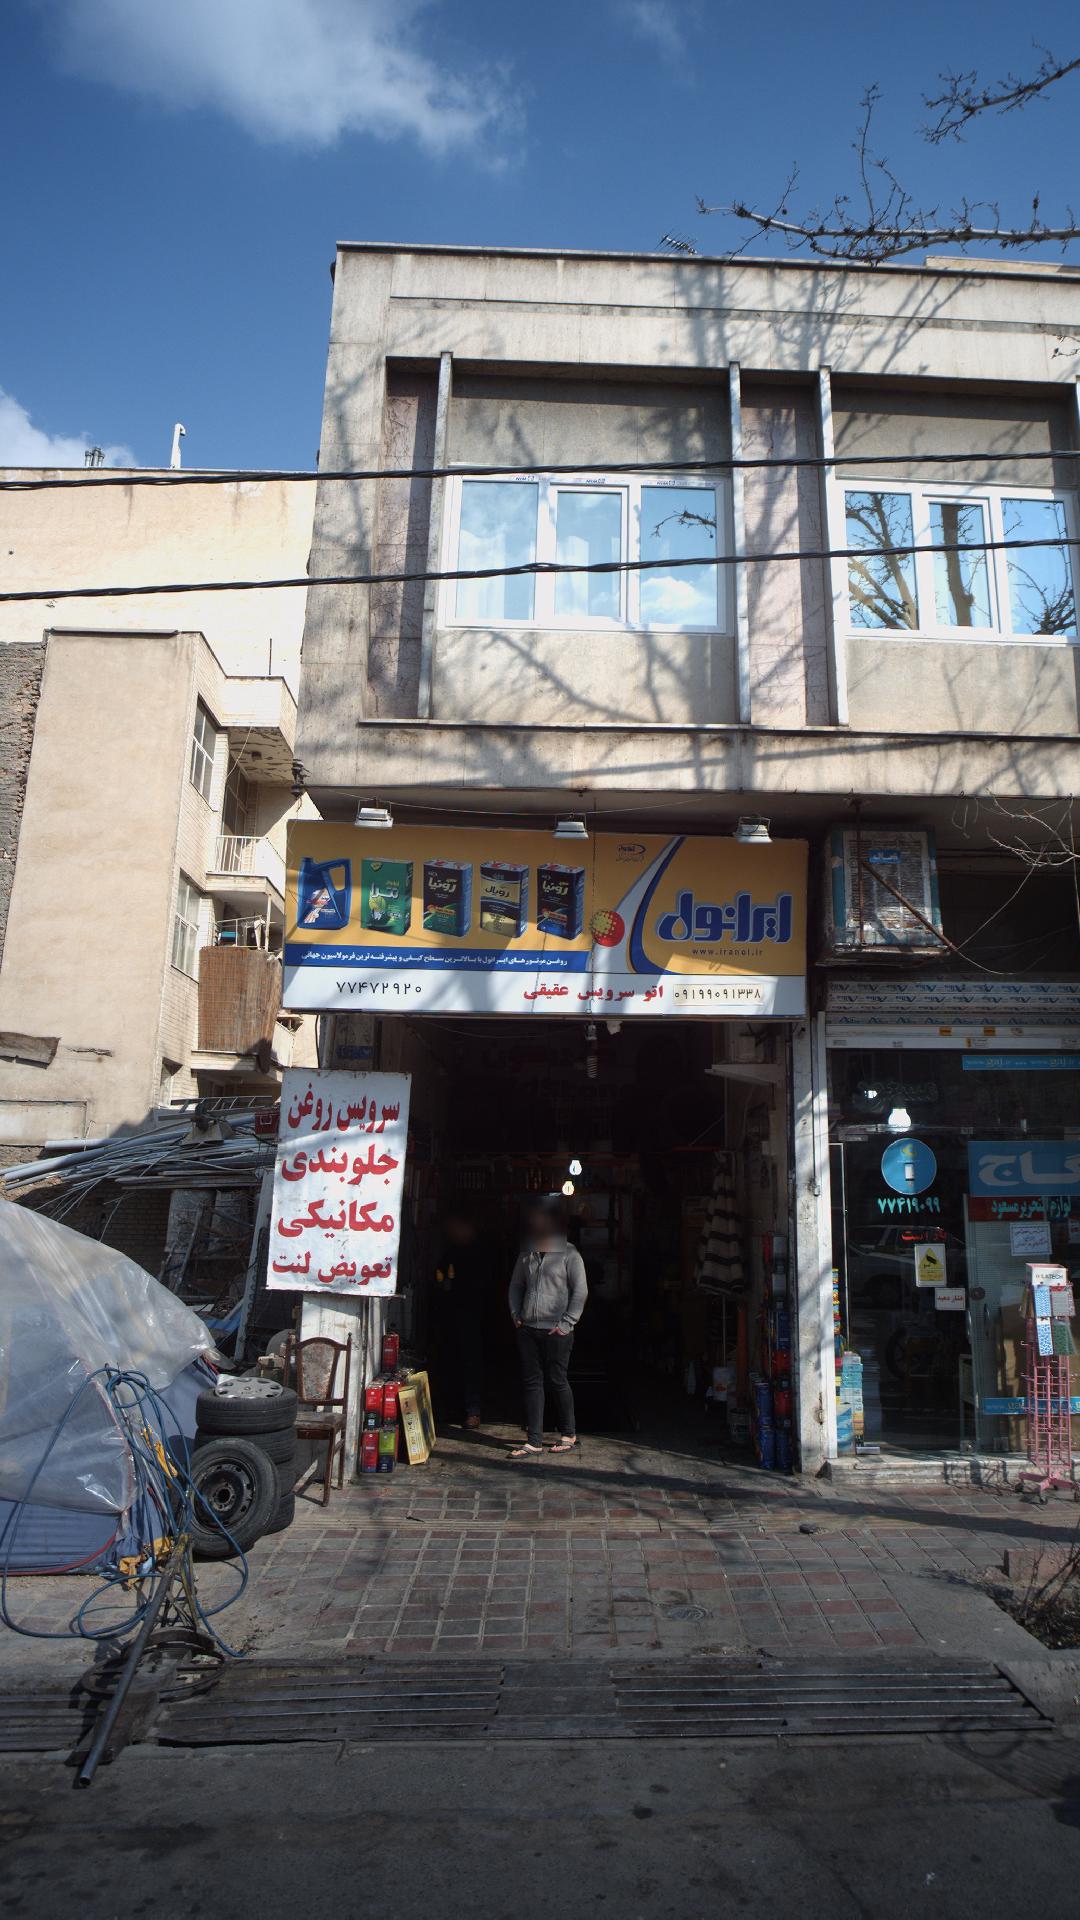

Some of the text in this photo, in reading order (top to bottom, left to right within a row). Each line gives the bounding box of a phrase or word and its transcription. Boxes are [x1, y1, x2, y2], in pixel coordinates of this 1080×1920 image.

[656, 889, 793, 943] ایرانول
[546, 957, 568, 966] روغن
[692, 947, 764, 957] www.iranol.ir
[523, 983, 664, 1002] اتو سرویس عقیقی
[287, 1082, 401, 1134] سرویس روغن
[281, 1143, 400, 1186] جلوبندی
[278, 1199, 395, 1239] مکانیکی
[272, 1251, 393, 1286] تعویض لنت
